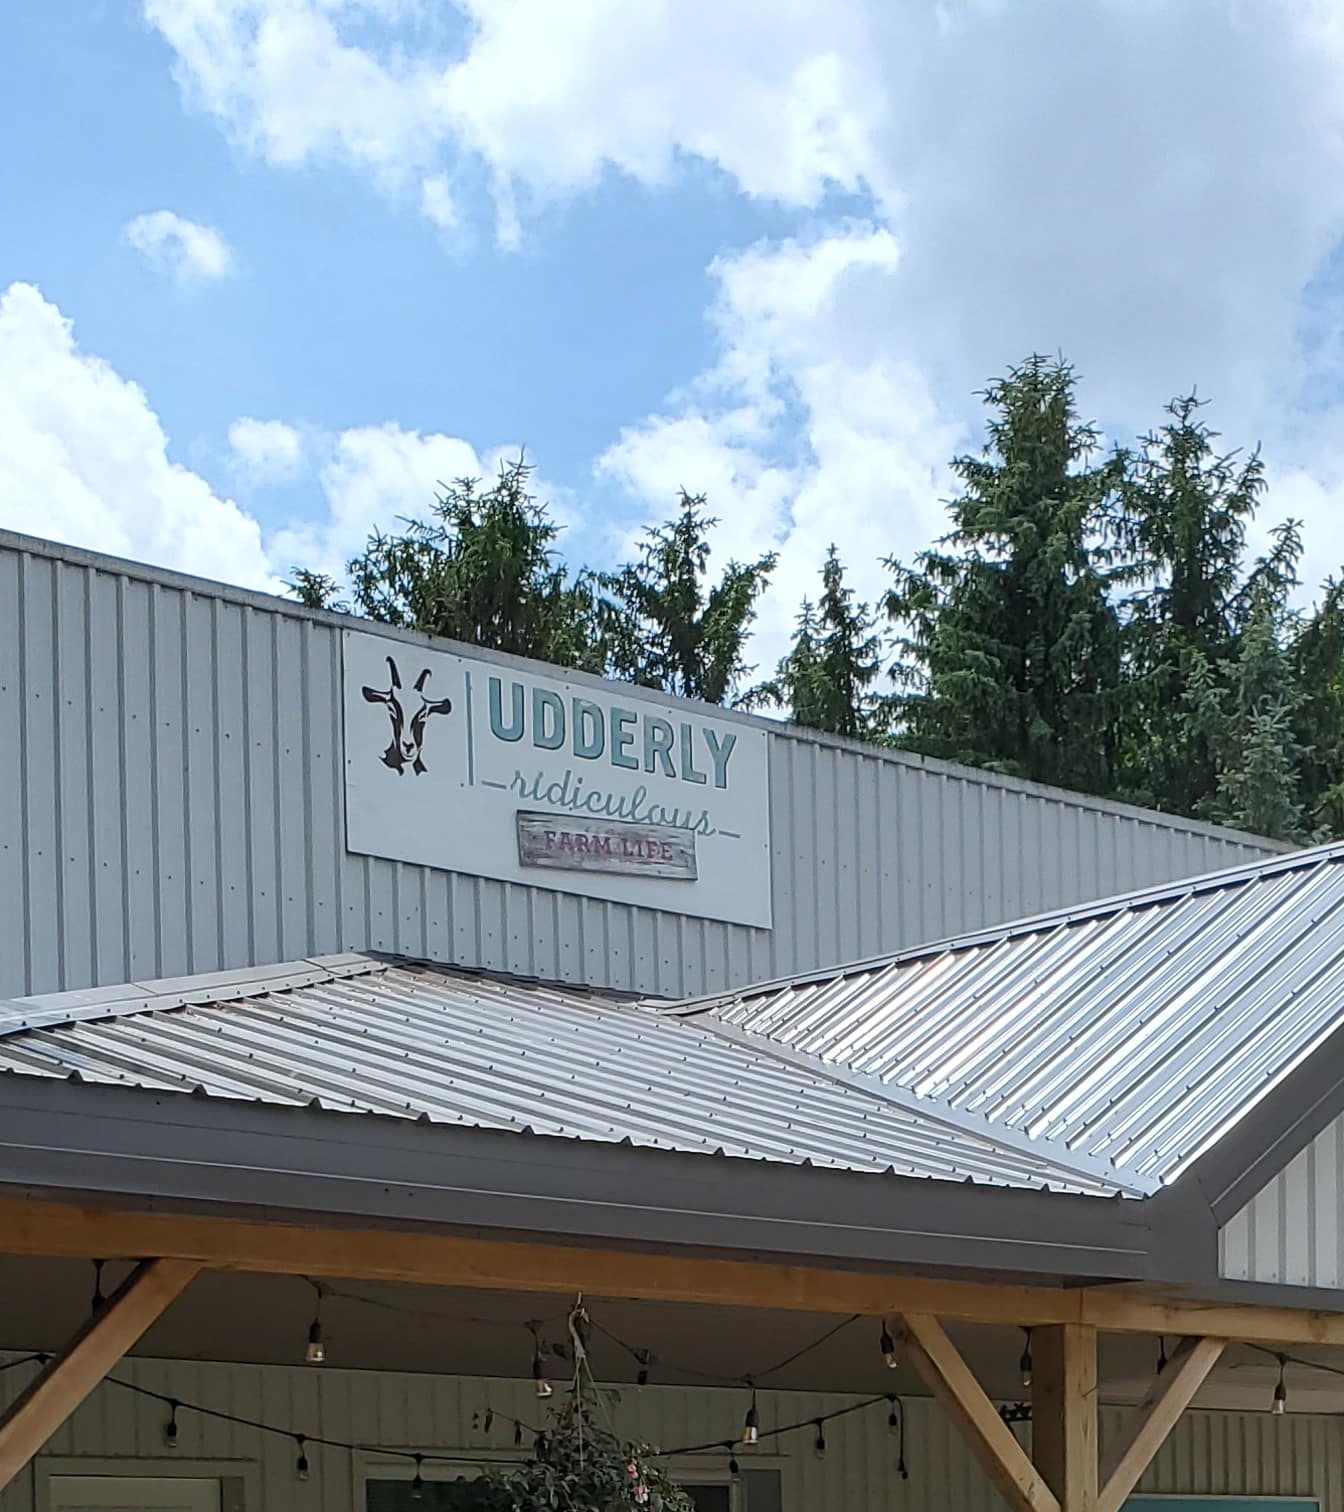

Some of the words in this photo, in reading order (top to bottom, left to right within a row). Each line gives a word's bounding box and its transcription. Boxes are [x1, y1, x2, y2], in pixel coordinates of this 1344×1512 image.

[488, 676, 737, 789] UDDERLY
[510, 769, 716, 836] ridiculous
[543, 830, 611, 856] FARM
[620, 837, 673, 861] LIFE
